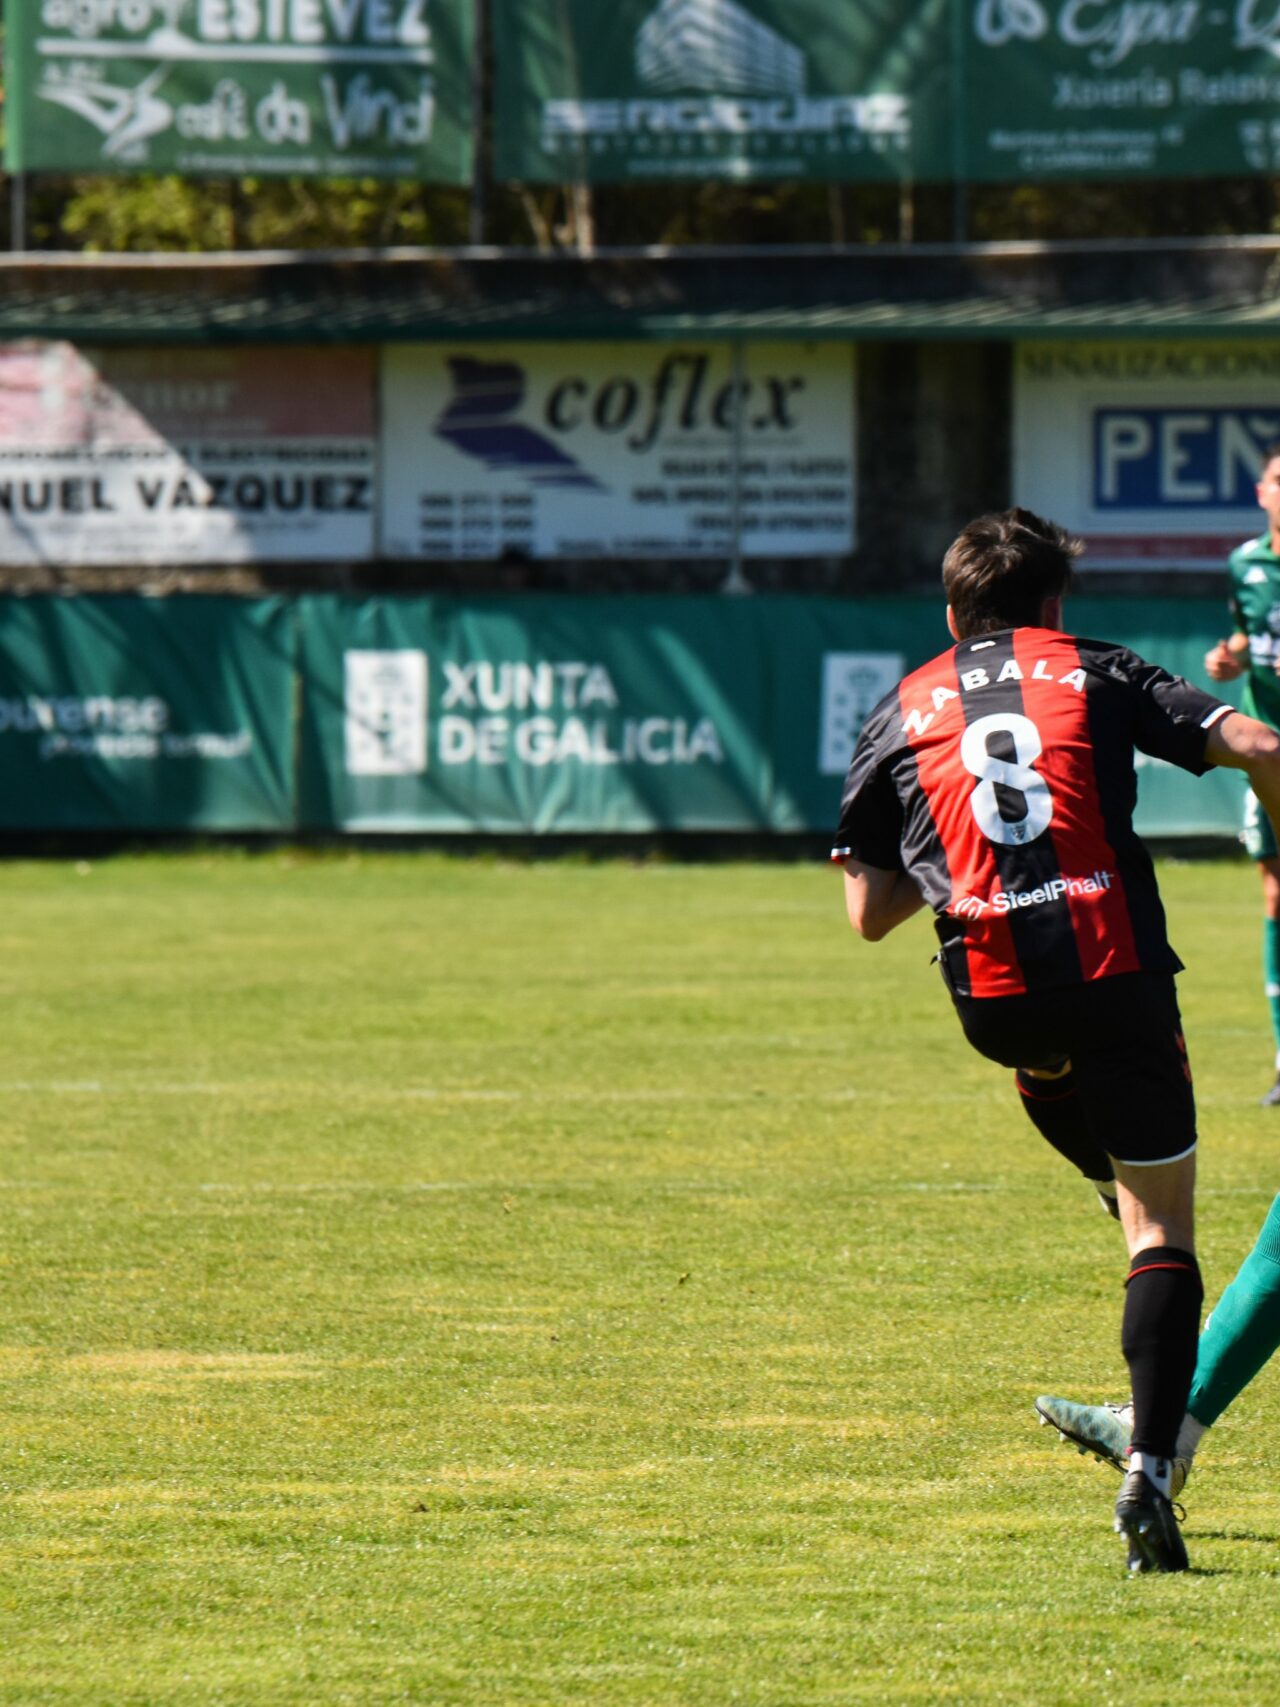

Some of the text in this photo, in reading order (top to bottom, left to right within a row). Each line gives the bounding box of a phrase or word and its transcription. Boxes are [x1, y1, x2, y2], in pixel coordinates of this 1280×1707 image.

[545, 350, 806, 454] coflex
[441, 661, 618, 710] XUNTA
[901, 660, 1086, 735] ZABALA
[438, 717, 723, 764] DE GALICIA
[960, 713, 1053, 846] 8
[992, 871, 1112, 913] SteelPhalt
